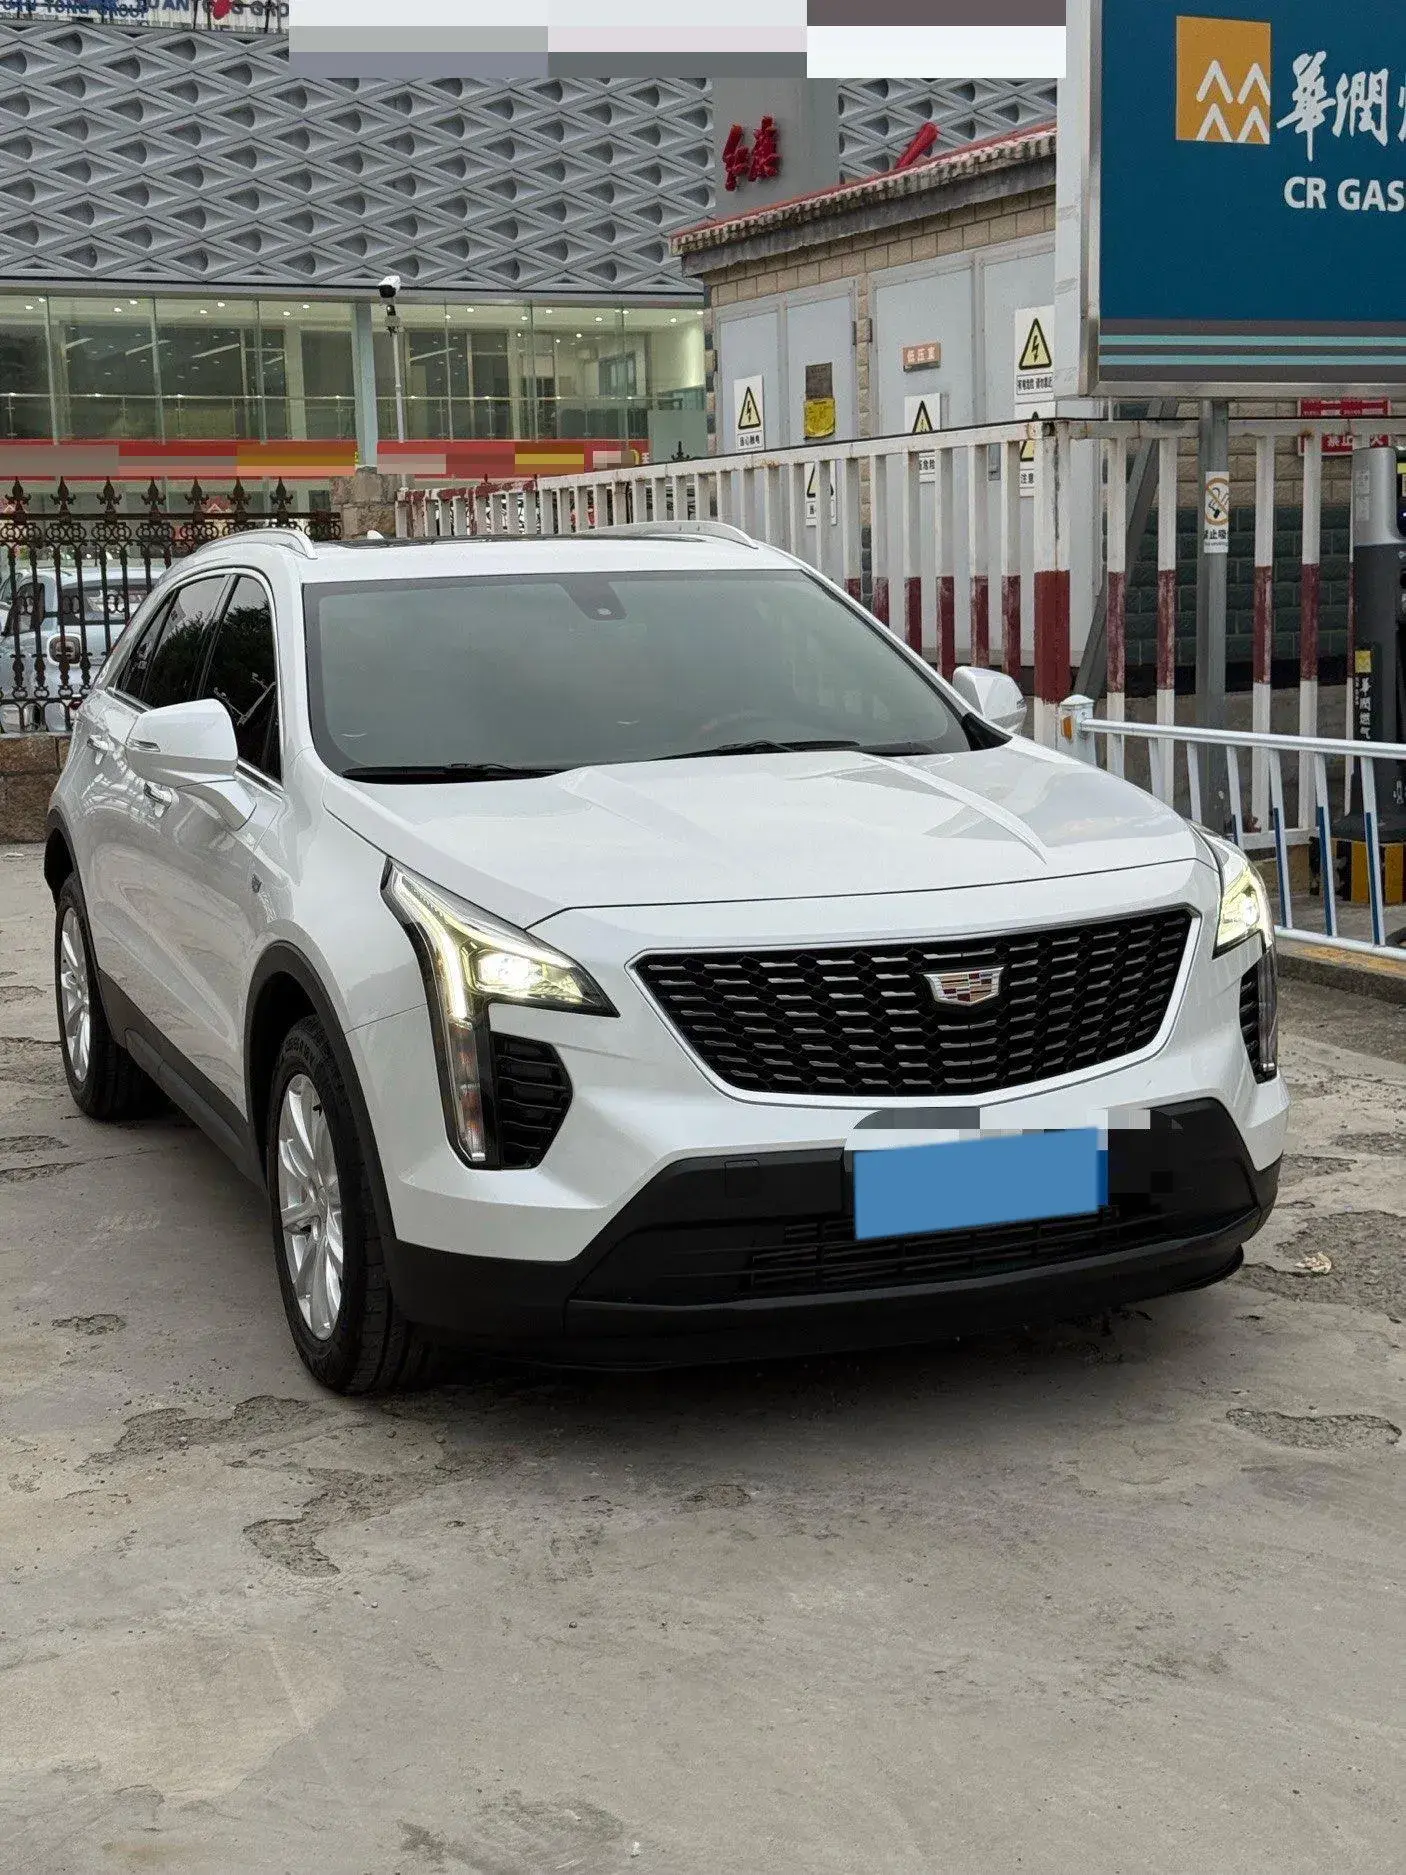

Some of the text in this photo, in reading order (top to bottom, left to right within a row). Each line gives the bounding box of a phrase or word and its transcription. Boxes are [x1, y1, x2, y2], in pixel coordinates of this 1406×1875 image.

[1276, 50, 1406, 163] 華潤
[1283, 176, 1406, 213] CR GAS
